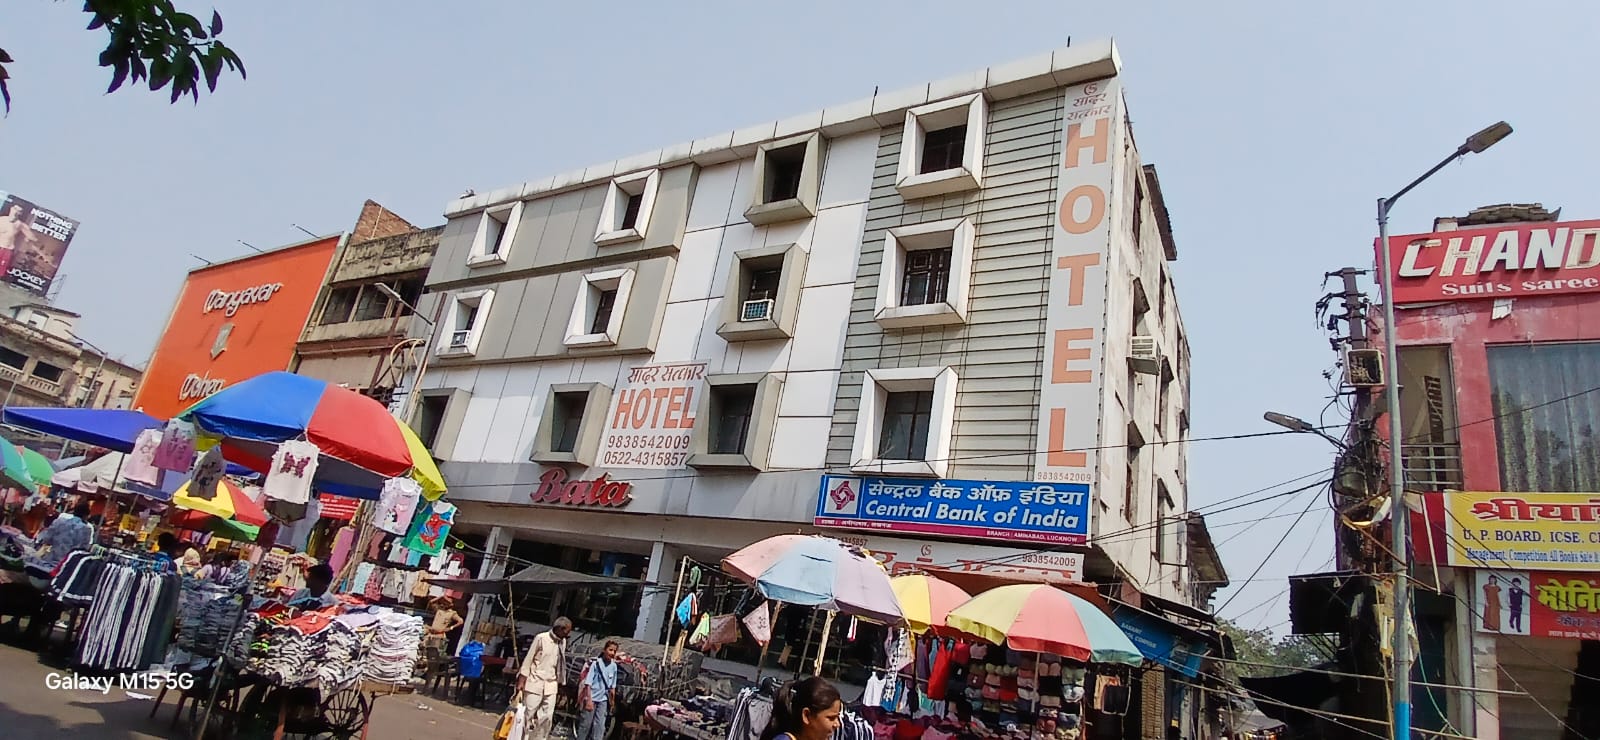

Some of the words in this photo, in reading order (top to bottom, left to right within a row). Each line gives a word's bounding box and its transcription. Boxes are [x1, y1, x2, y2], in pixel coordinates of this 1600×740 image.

[31, 208, 73, 230] NOTHING
[7, 268, 46, 286] JOCKEY
[1047, 118, 1109, 468] HOTEL
[626, 366, 661, 385] सादर
[611, 387, 696, 430] HOTEL
[607, 434, 690, 450] 9838542009
[603, 450, 687, 466] 0522-4315857
[530, 466, 633, 507] Bata
[929, 481, 963, 500] बैंक
[1018, 485, 1084, 506] इंडिया
[865, 499, 931, 520] Central
[935, 503, 988, 523] Bank
[993, 506, 1018, 526] of
[1021, 510, 1079, 529] India
[1022, 554, 1076, 567] 9838542009
